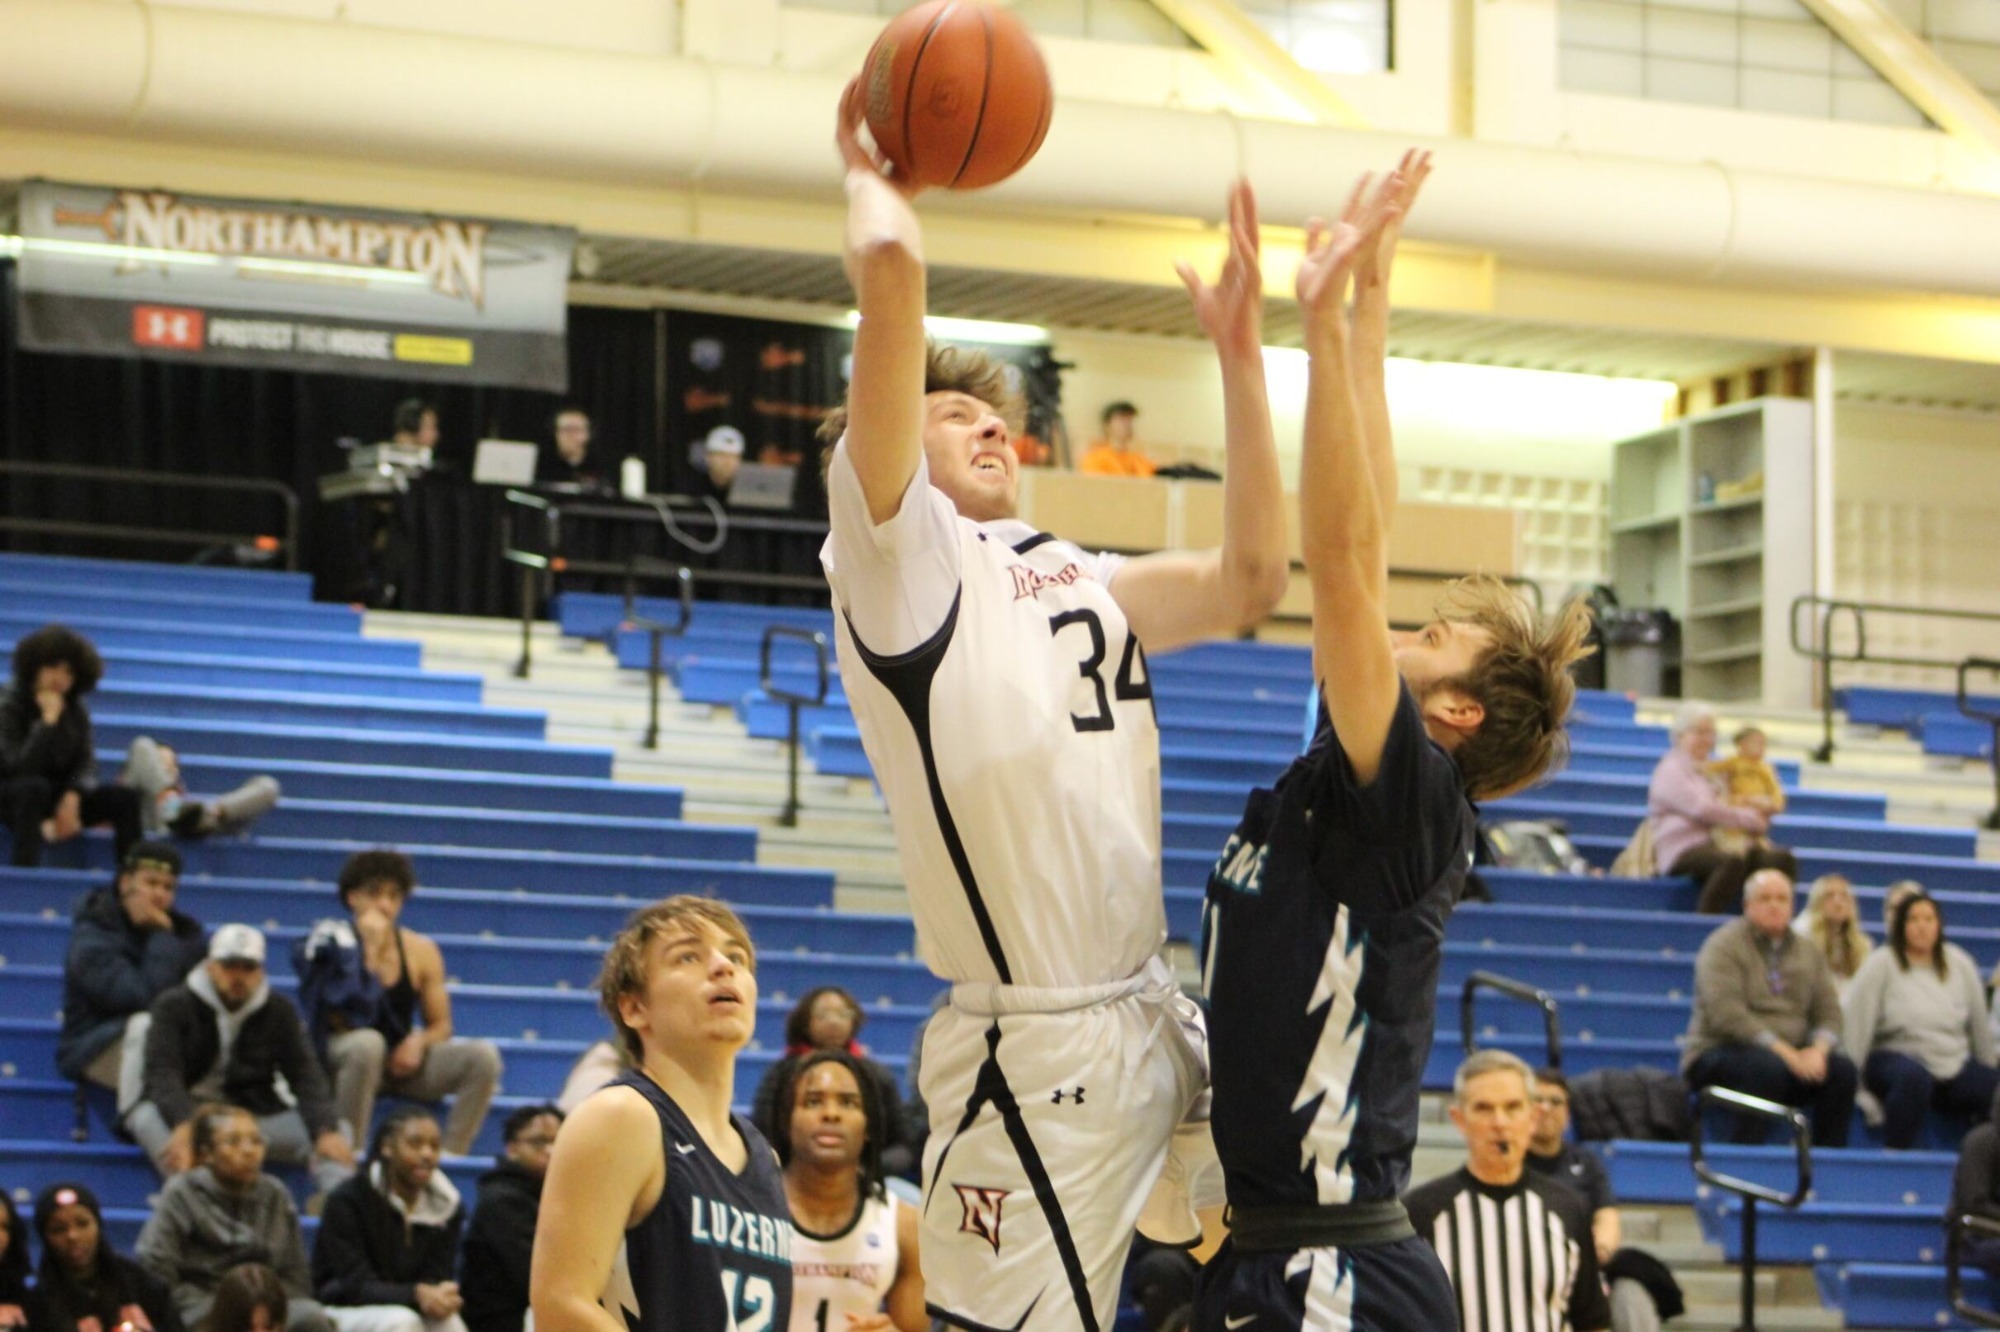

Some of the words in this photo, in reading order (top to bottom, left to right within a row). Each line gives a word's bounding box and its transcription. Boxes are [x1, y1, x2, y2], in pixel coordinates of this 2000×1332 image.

[207, 317, 294, 351] PROTECT
[1048, 607, 1157, 733] 34
[690, 1195, 792, 1266] LUZERN
[720, 1268, 776, 1332] 12
